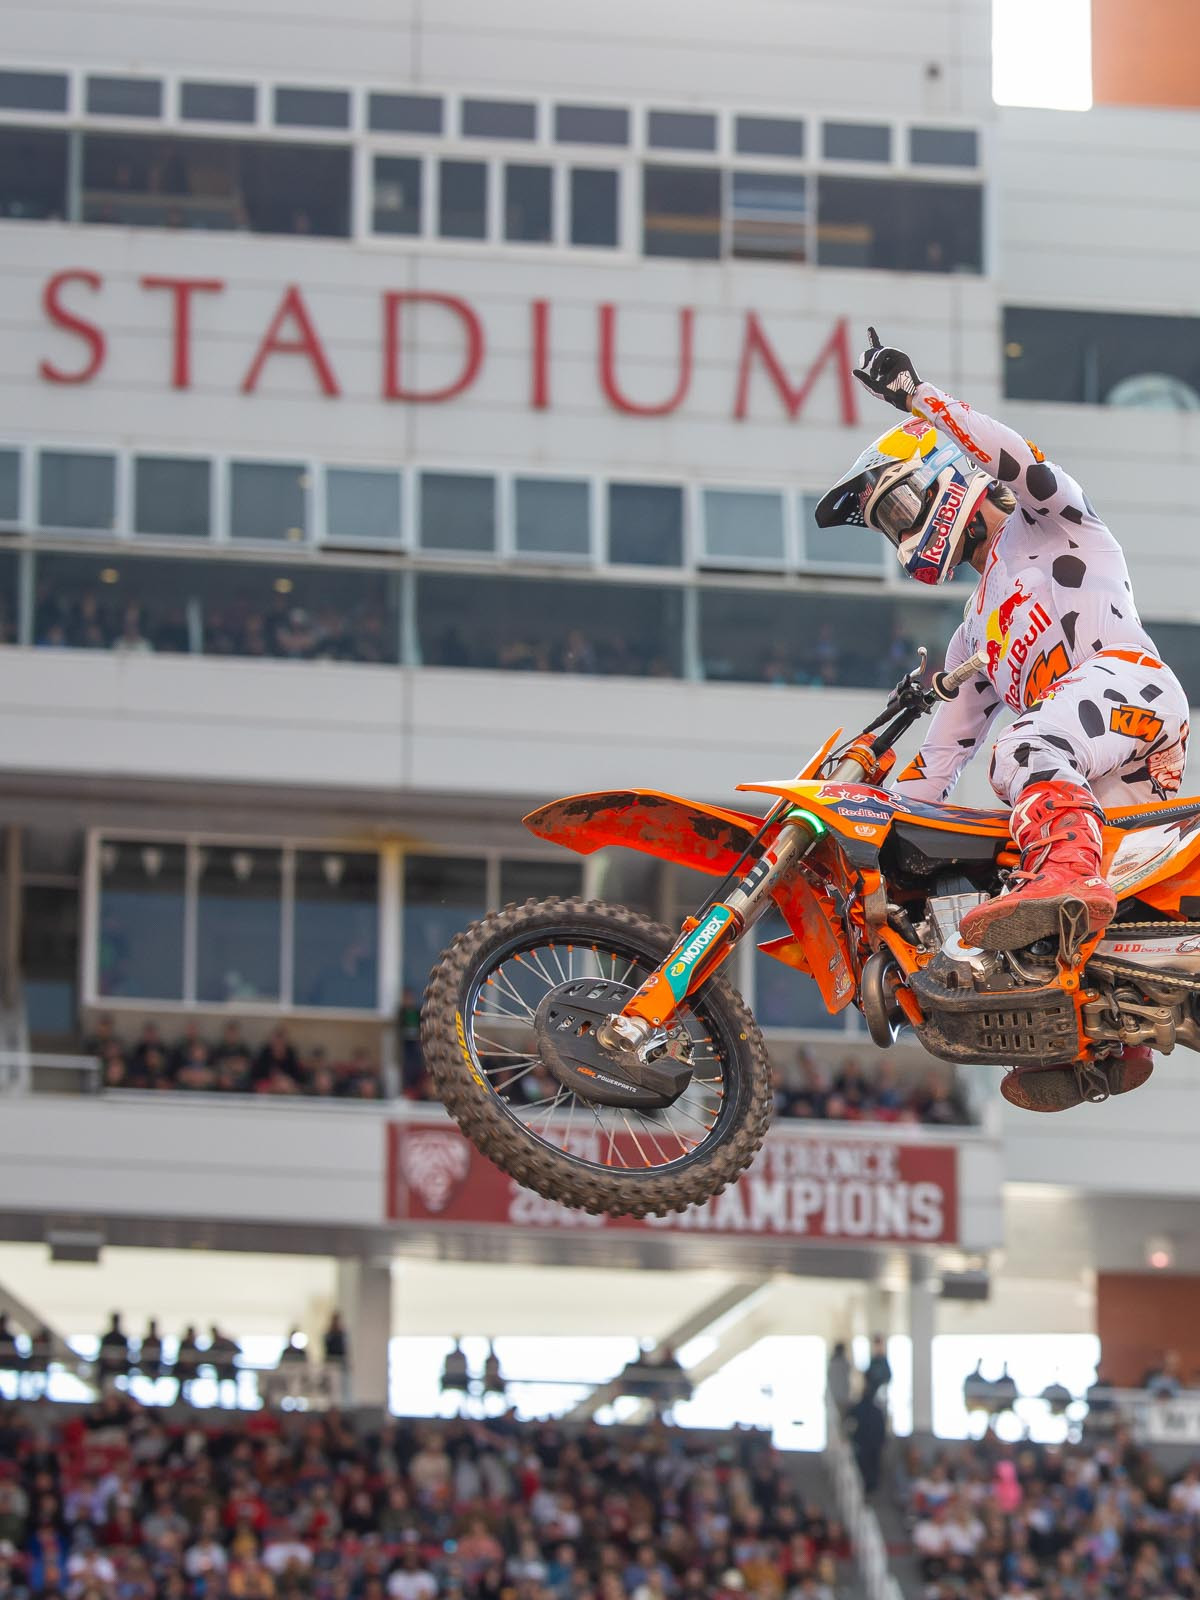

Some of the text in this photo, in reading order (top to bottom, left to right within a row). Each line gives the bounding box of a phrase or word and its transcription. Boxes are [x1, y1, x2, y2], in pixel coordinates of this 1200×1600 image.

[38, 268, 860, 429] STADIUM
[1109, 704, 1165, 742] KTM
[1109, 815, 1131, 826] LOMA
[1132, 811, 1157, 820] LINDA
[679, 914, 725, 965] MOTOREX
[597, 1075, 637, 1093] POWERPARTS
[645, 1178, 944, 1240] HAMPIONS
